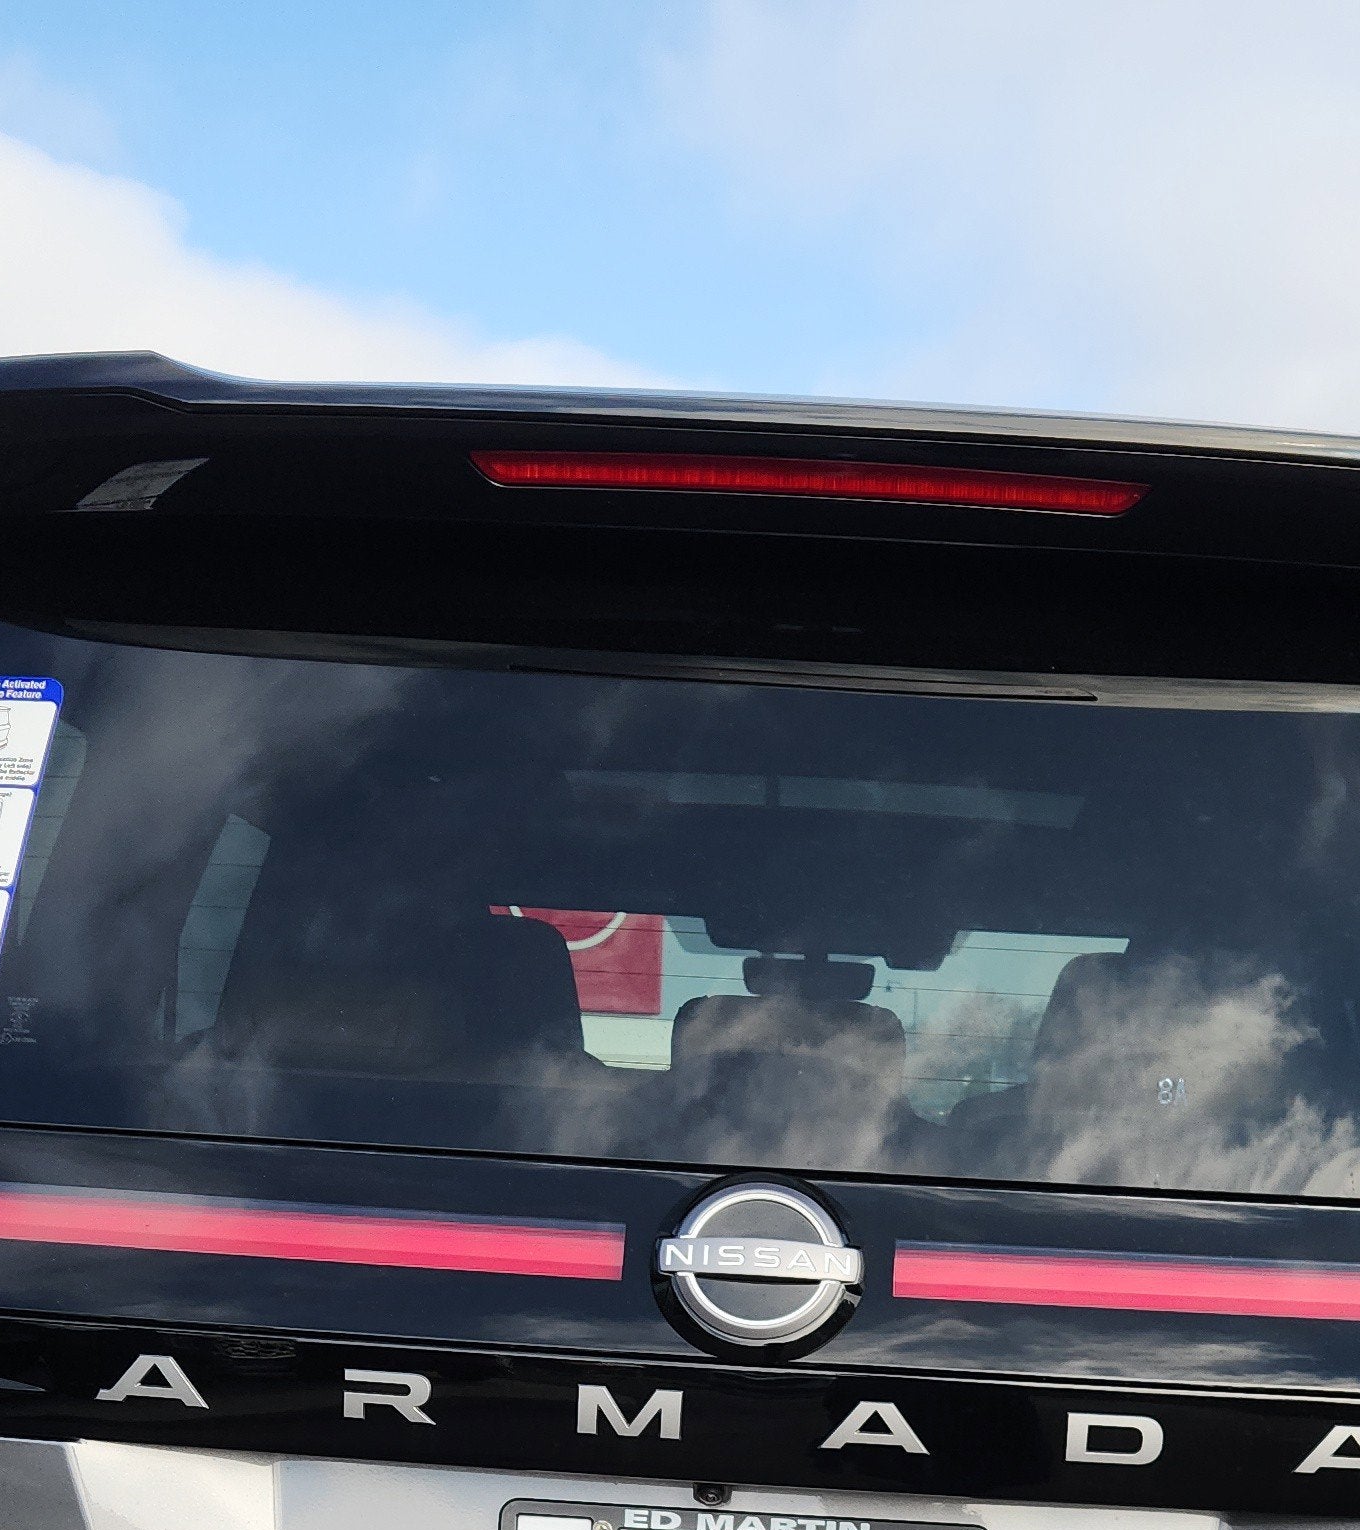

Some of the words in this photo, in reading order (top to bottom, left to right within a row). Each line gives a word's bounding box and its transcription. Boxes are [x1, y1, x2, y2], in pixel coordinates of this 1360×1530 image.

[2, 679, 47, 690] Activated
[6, 690, 42, 699] Feature
[664, 1243, 852, 1276] NISSAN
[623, 1508, 682, 1530] ED
